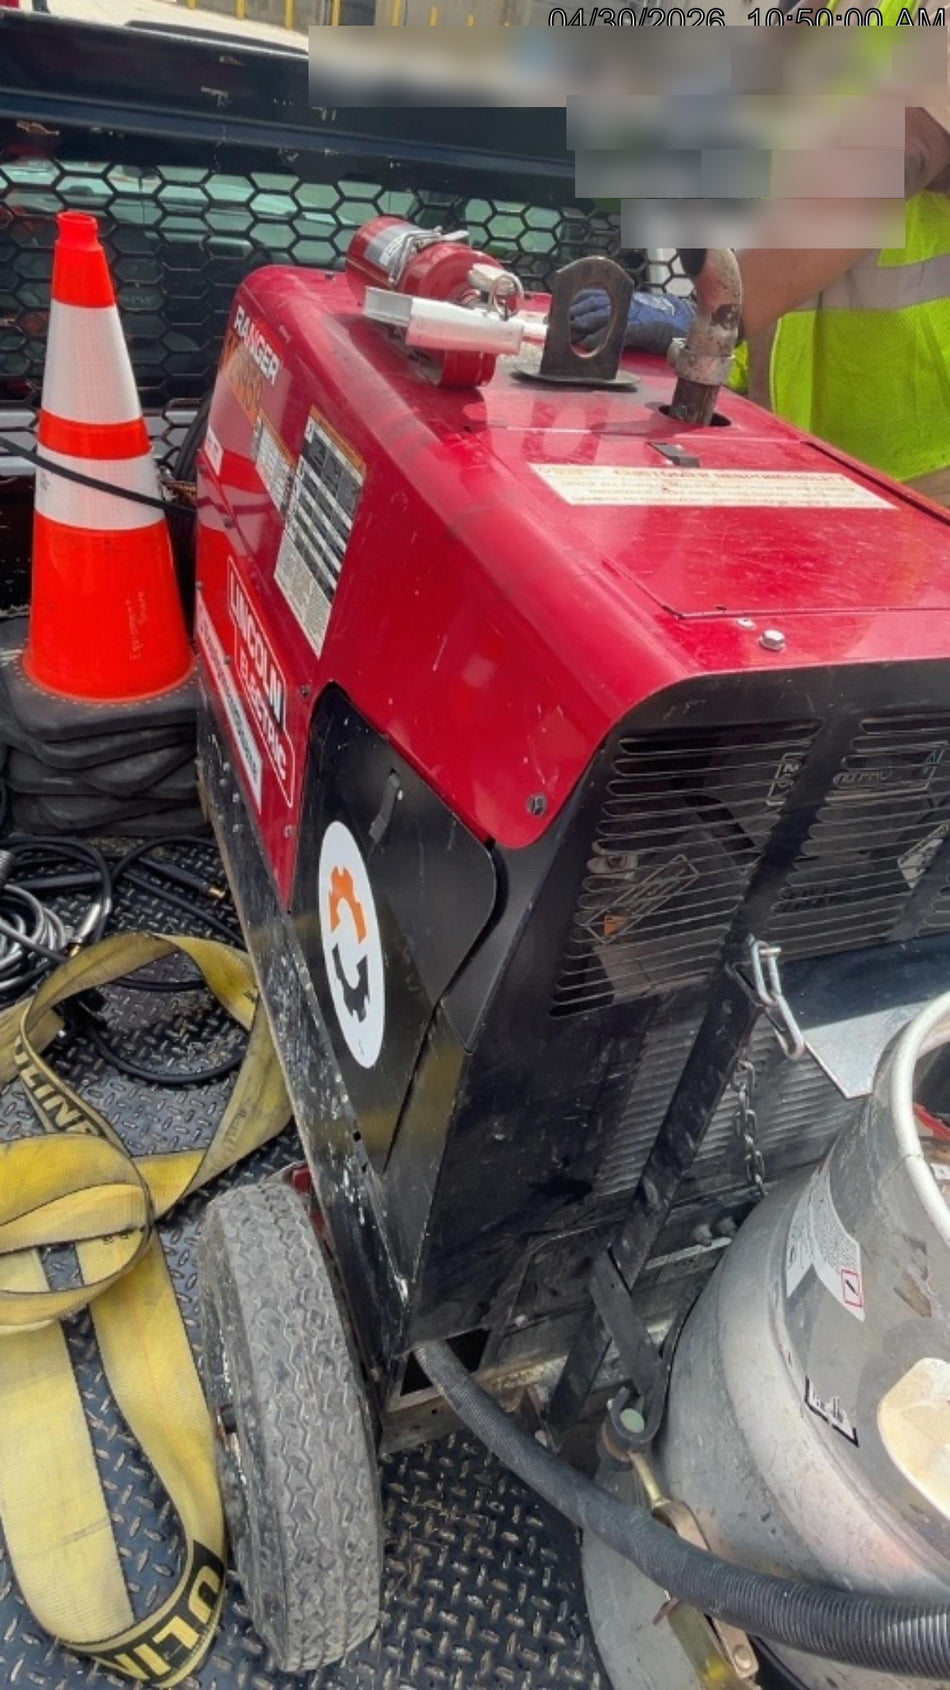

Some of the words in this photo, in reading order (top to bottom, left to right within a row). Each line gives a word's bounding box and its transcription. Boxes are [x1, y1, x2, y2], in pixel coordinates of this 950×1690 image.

[233, 304, 280, 386] RANGER
[230, 570, 284, 728] LINCOLN
[239, 645, 287, 781] ELECTRIC
